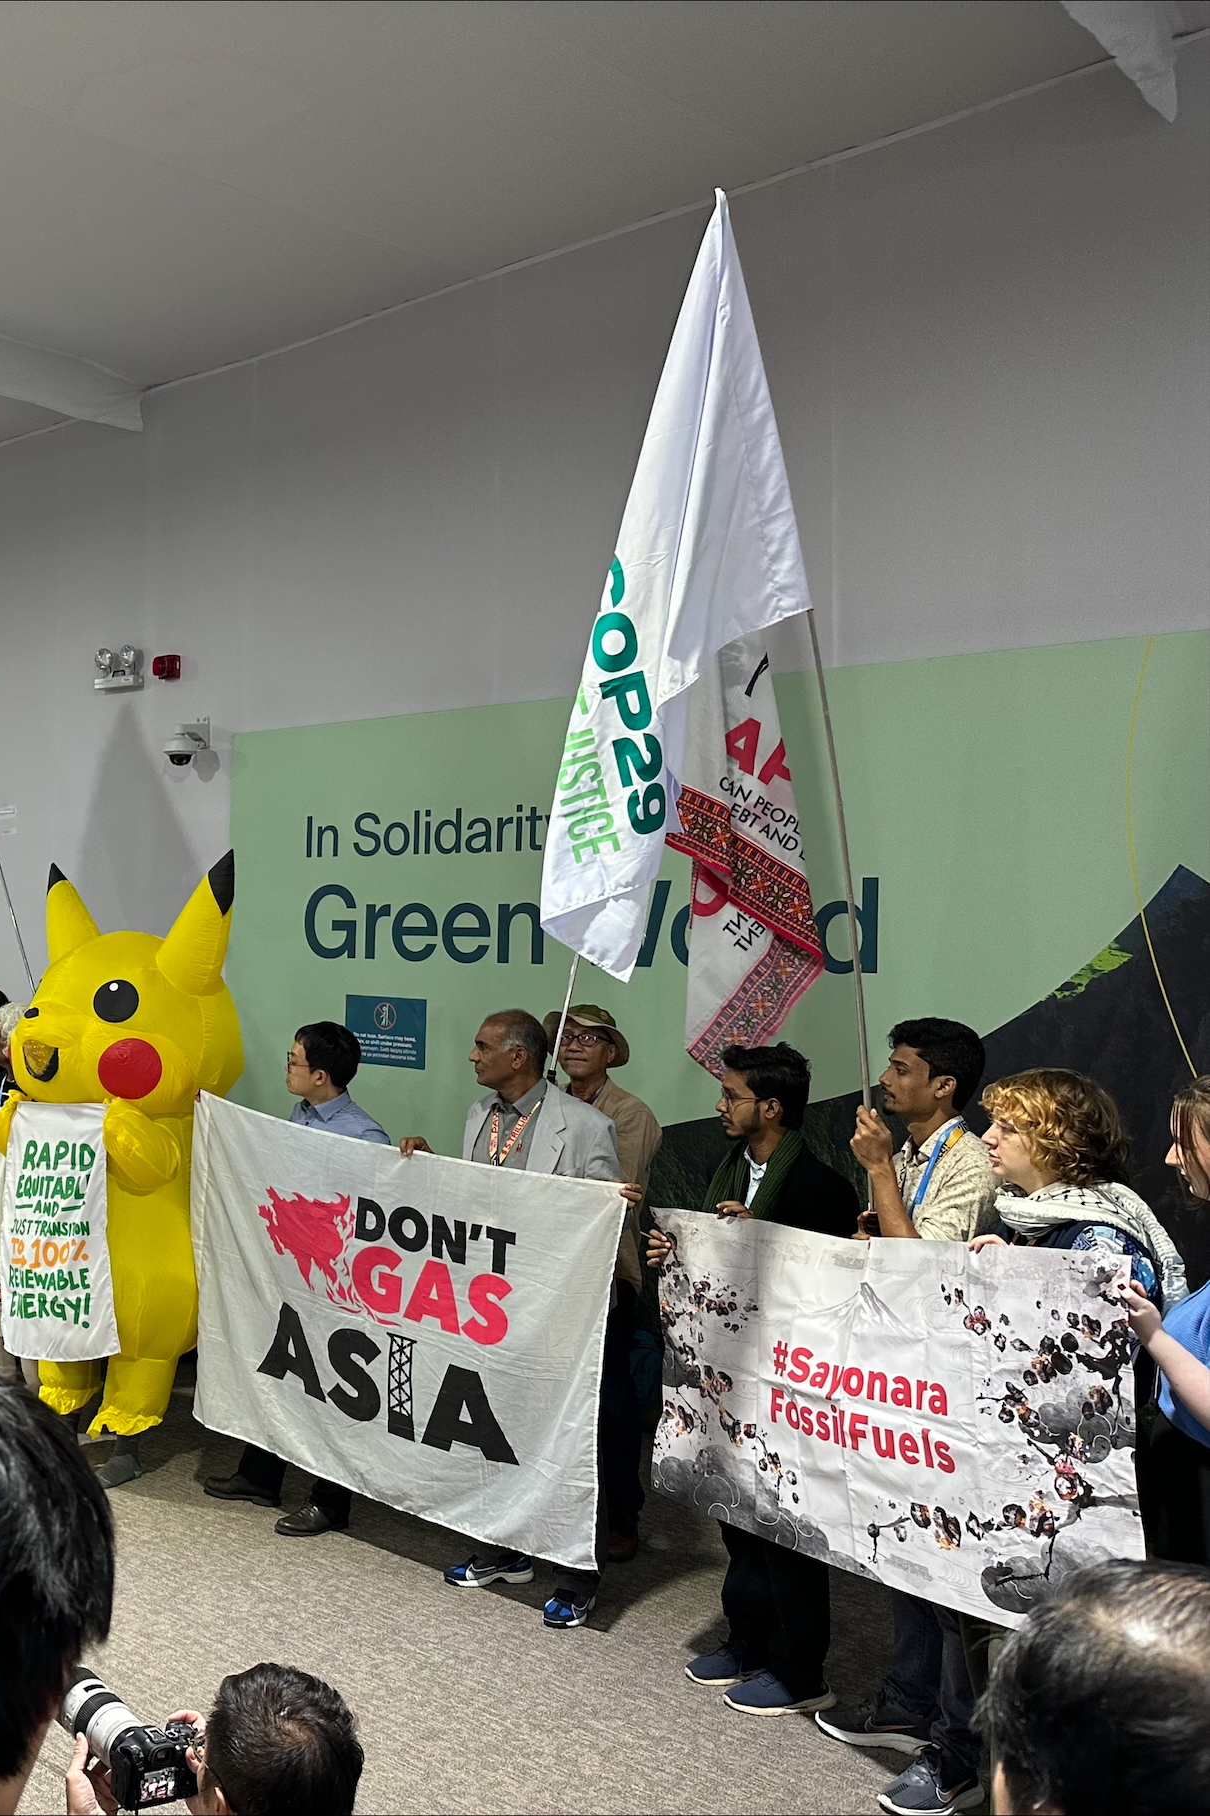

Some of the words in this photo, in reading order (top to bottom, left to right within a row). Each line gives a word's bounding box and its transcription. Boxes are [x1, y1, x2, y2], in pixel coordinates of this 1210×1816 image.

[306, 815, 339, 858] In
[353, 804, 550, 857] Solidarit
[759, 819, 799, 853] AND
[304, 883, 544, 965] Green
[22, 1139, 96, 1172] RAPID
[15, 1174, 91, 1200] EQUITABL
[33, 1199, 59, 1218] AND
[10, 1218, 33, 1235] JUST
[34, 1220, 90, 1237] TRANSITON
[355, 1196, 517, 1276] DON'T
[11, 1238, 25, 1256] TO
[29, 1238, 89, 1270] 100%
[8, 1267, 90, 1291] RENEWABLE
[351, 1245, 513, 1346] GAS
[9, 1292, 91, 1329] ENERGY!
[256, 1301, 520, 1466] ASIA
[772, 1340, 948, 1417] #Sayonara
